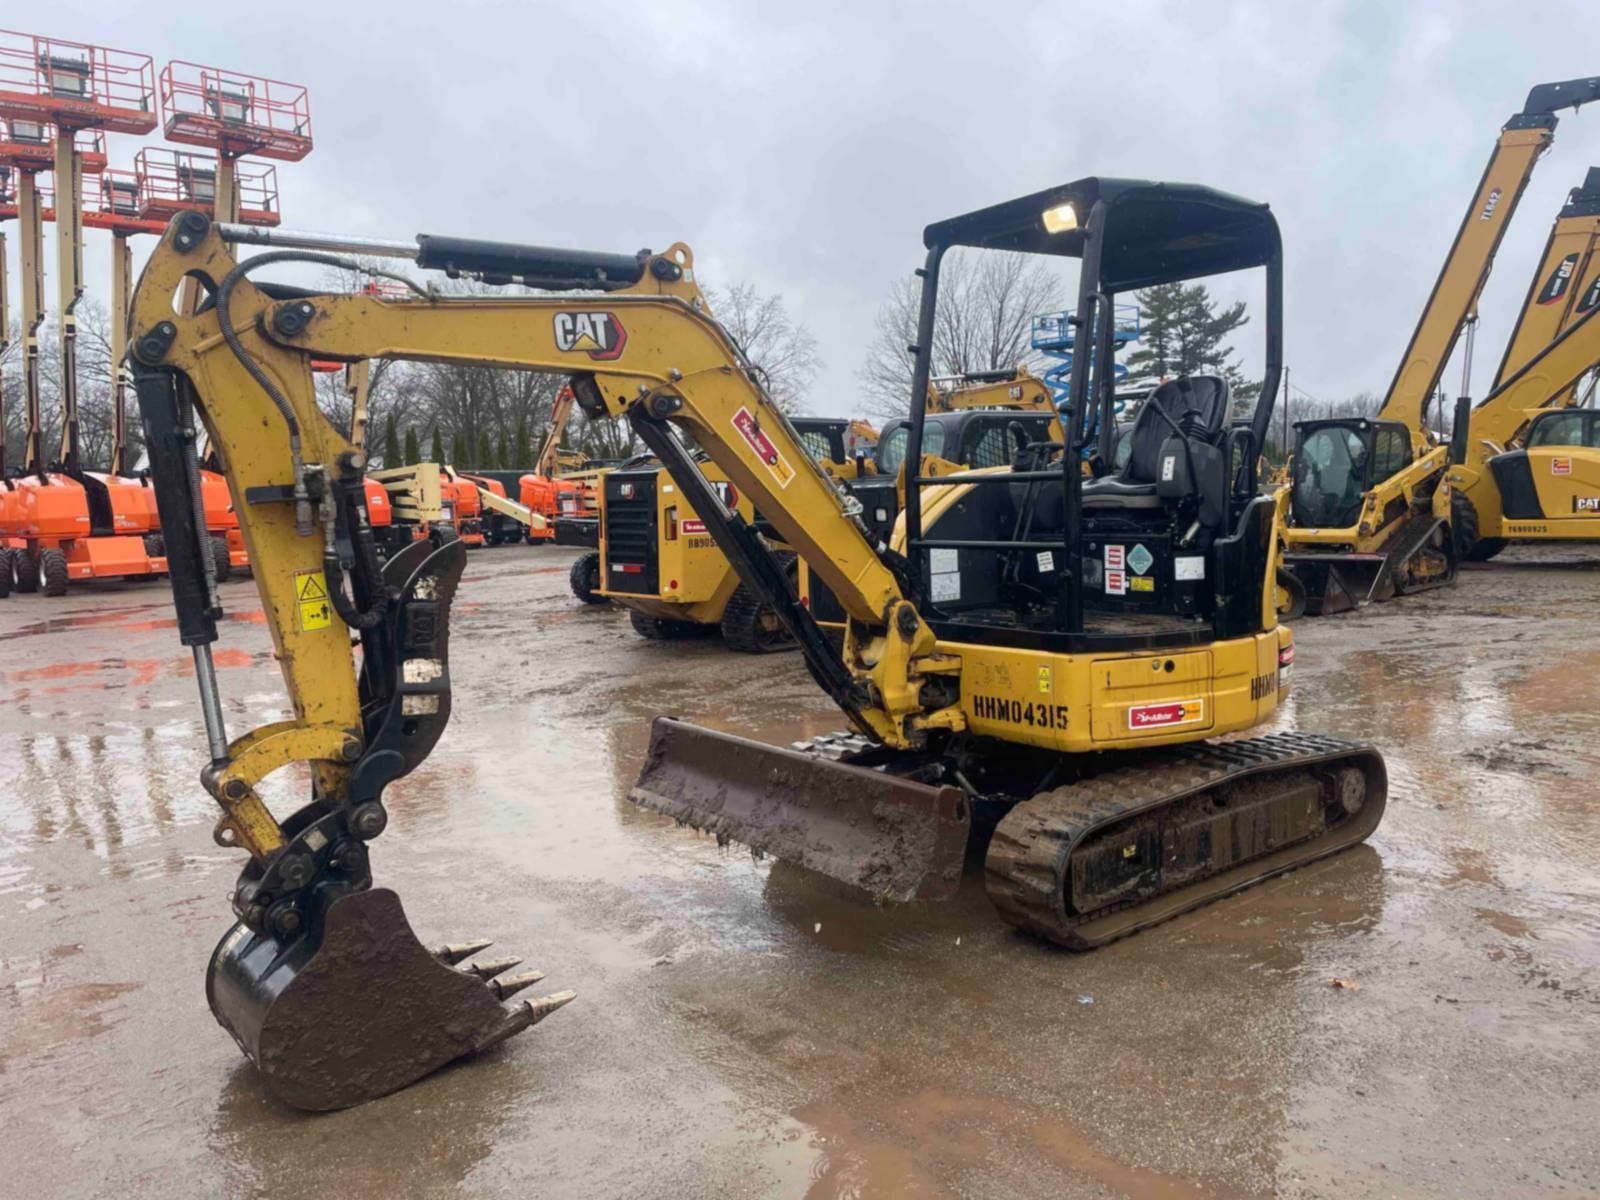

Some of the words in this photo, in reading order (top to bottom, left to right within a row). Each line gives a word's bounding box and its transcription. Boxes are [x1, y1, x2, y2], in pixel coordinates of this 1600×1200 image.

[1558, 260, 1575, 278] CAT
[554, 312, 608, 351] CAT
[1578, 498, 1600, 510] CAT
[973, 695, 1069, 730] HHM04315
